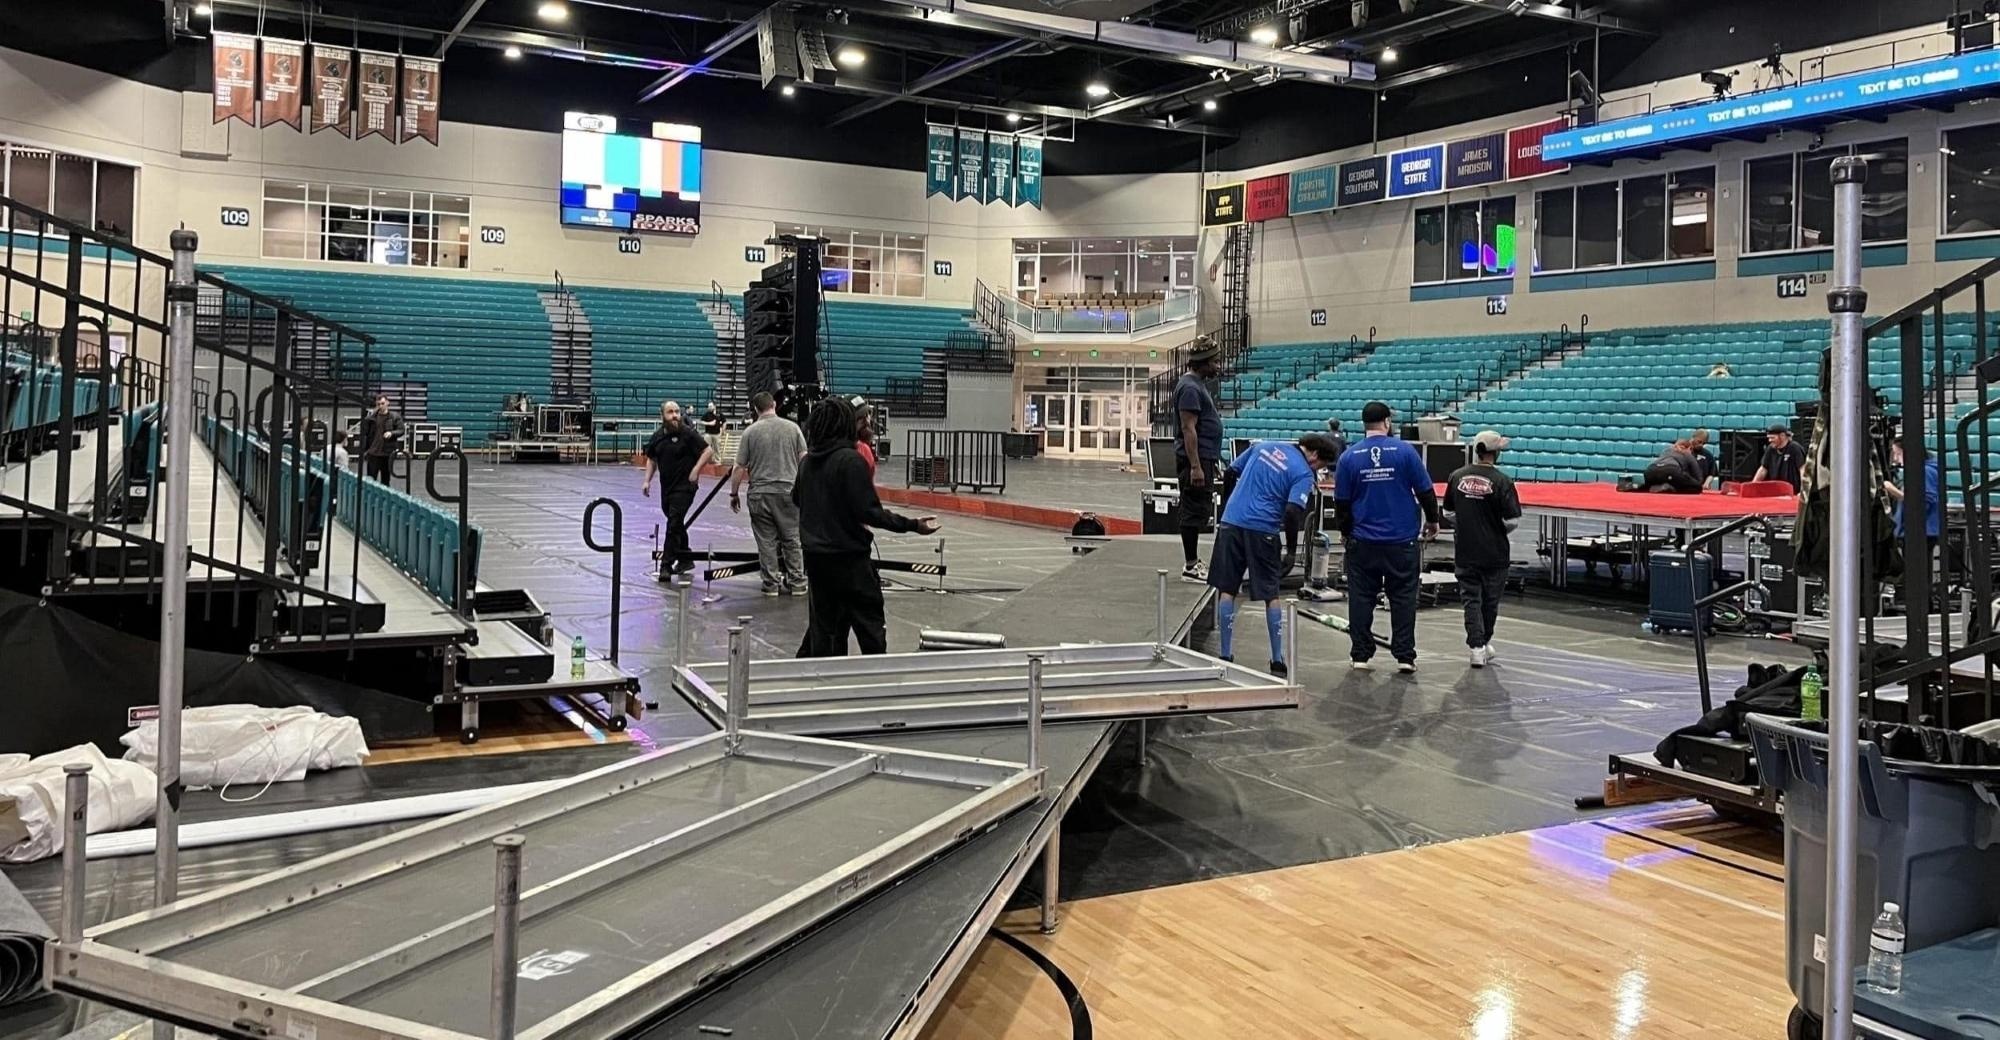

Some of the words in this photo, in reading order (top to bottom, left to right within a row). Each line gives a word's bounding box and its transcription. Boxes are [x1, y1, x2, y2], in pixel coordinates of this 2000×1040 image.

[1858, 81, 1886, 95] TEXT
[1905, 75, 1920, 87] TO
[1707, 109, 1731, 122] TEXT
[1746, 104, 1760, 115] TO
[1581, 134, 1601, 146] TEXT
[1614, 129, 1625, 140] TO
[1462, 148, 1488, 162] JAMES
[1401, 158, 1431, 173] GEORGIA
[1457, 161, 1493, 177] MADISON
[1348, 168, 1376, 182] GEORGIA
[1404, 172, 1428, 185] STATE
[1299, 178, 1326, 191] COASTAL
[1345, 180, 1379, 195] SOUTHERN
[1218, 195, 1231, 206] APP
[222, 210, 249, 224] 109
[1215, 205, 1233, 217] STATE
[635, 213, 696, 226] SPARKS
[634, 221, 697, 233] TOYOTA
[481, 229, 504, 242] 109
[620, 239, 640, 252] 110
[747, 249, 764, 261] 111
[936, 263, 951, 274] 111
[1780, 279, 1805, 295] 114
[1488, 300, 1506, 313] 113
[1311, 312, 1325, 324] 112
